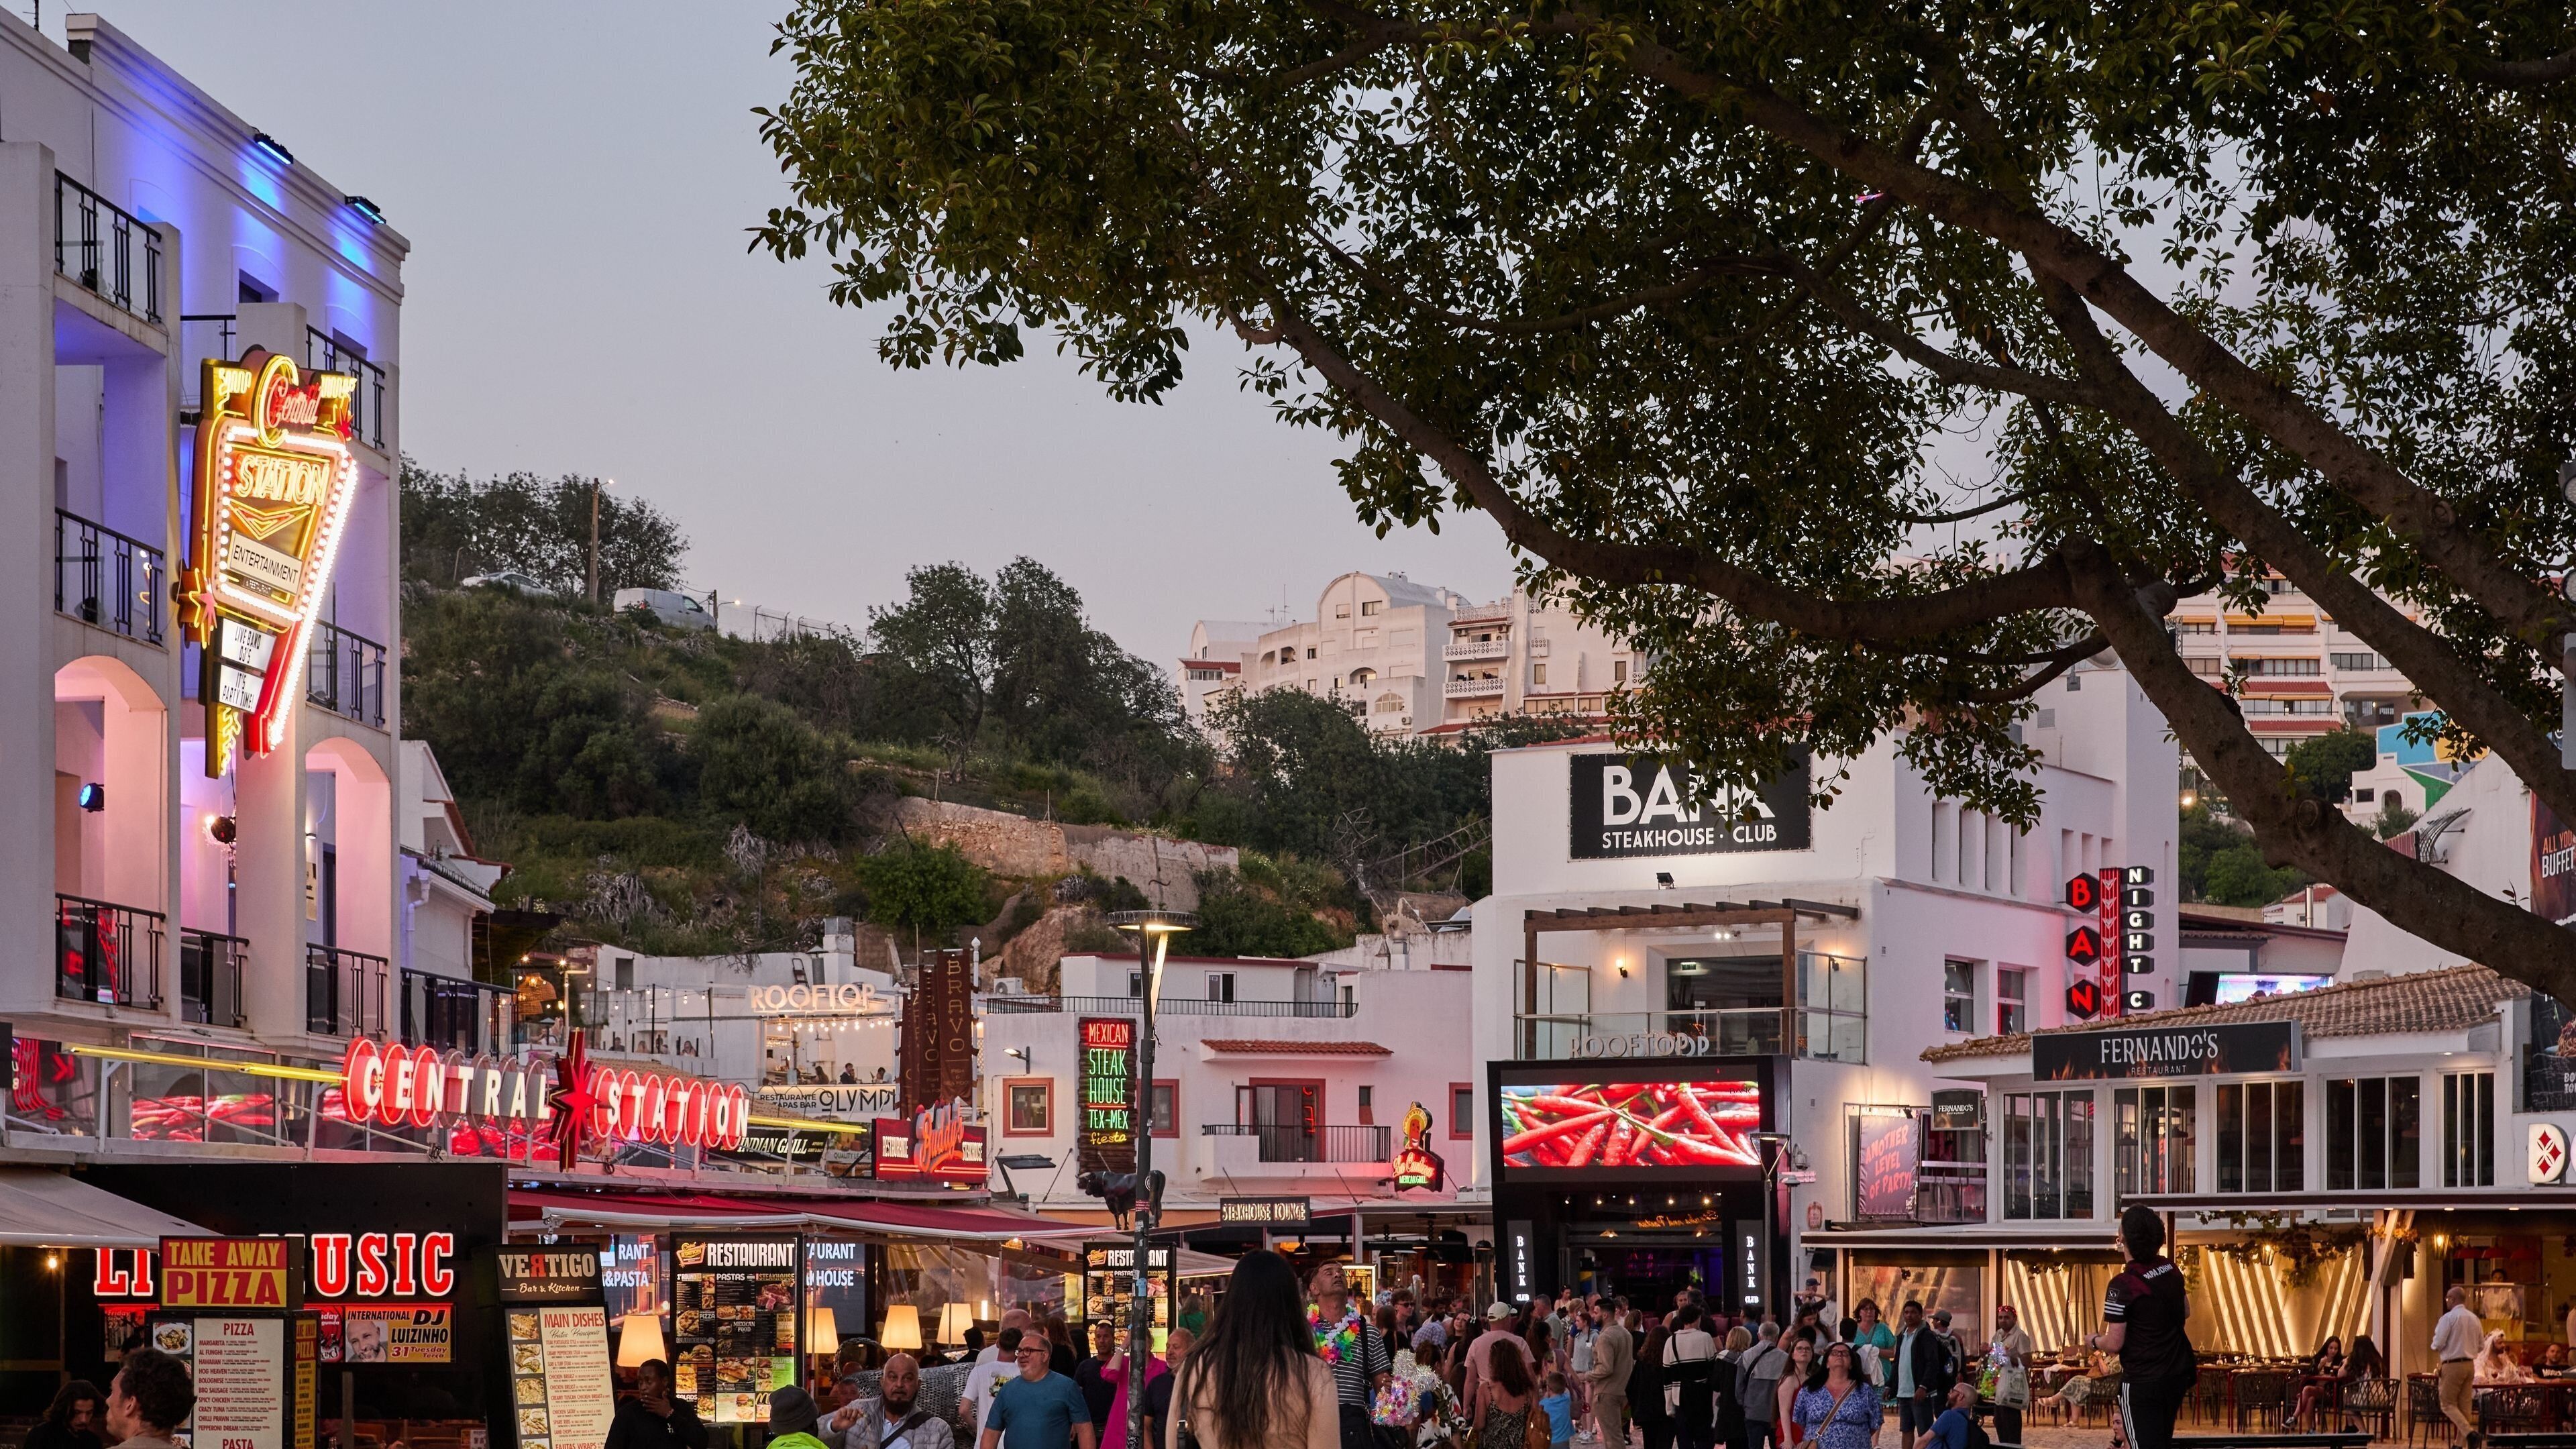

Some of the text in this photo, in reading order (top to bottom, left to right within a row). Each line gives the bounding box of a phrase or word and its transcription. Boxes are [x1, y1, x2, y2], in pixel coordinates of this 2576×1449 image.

[236, 455, 330, 506] STATION
[233, 545, 299, 583] ENTERTAINMENT
[235, 625, 262, 649] LIVE BAND
[235, 672, 246, 690] IT'S
[222, 685, 254, 709] PARTY TIME!
[1603, 824, 1777, 849] STEAKHOUSE CLUB
[2542, 829, 2573, 855] ALL YOU
[2542, 847, 2575, 878] BUFFET
[2129, 868, 2143, 973] NIGHT
[2069, 878, 2094, 1012] BAN
[751, 984, 875, 1009] ROOFTOP
[947, 959, 965, 1052] BRAVO
[1089, 1024, 1128, 1043] MEXICAN
[1570, 1032, 1688, 1059] ROOFTOP
[2101, 1029, 2218, 1064] FERNANDO'S
[1089, 1049, 1127, 1075] STEAK
[2131, 1065, 2186, 1075] RESTAURANT
[364, 1055, 749, 1137] CENTRAL STATION
[761, 1093, 816, 1102] RESTAURANTE
[1089, 1077, 1126, 1104] HOUSE
[1089, 1109, 1128, 1129] TEX-MEX
[1938, 1104, 1974, 1112] FERNANDO'S
[737, 1136, 808, 1154] INDIAN GILL
[915, 1104, 965, 1173] Buddy's
[1090, 1132, 1127, 1144] fiesta
[1865, 1124, 1909, 1165] ANOTHER
[834, 1152, 853, 1160] QUALITY
[1875, 1150, 1900, 1176] LEVEL
[1870, 1171, 1912, 1199] OF PARTY!
[1222, 1202, 1305, 1221] STEAKHOUSE LOUNGE
[169, 1242, 280, 1267] TAKE AWAY
[619, 1244, 649, 1260] RANT
[707, 1243, 795, 1267] RESTAURANT
[1517, 1236, 1526, 1287] BANK
[1746, 1236, 1756, 1288] BANK
[166, 1271, 281, 1305] PIZZA
[519, 1283, 537, 1293] Bar
[548, 1282, 580, 1293] Kitchen
[347, 1311, 410, 1320] INTERNATIONAL
[413, 1309, 446, 1326] DJ
[545, 1313, 604, 1328] MAIN DISHES
[223, 1323, 254, 1336] PIZZA
[391, 1328, 448, 1344] LUIZINHO
[571, 1328, 600, 1339] Principais
[296, 1340, 315, 1359] PIZZA
[392, 1346, 409, 1357] 31
[223, 1439, 254, 1449] PASTA
